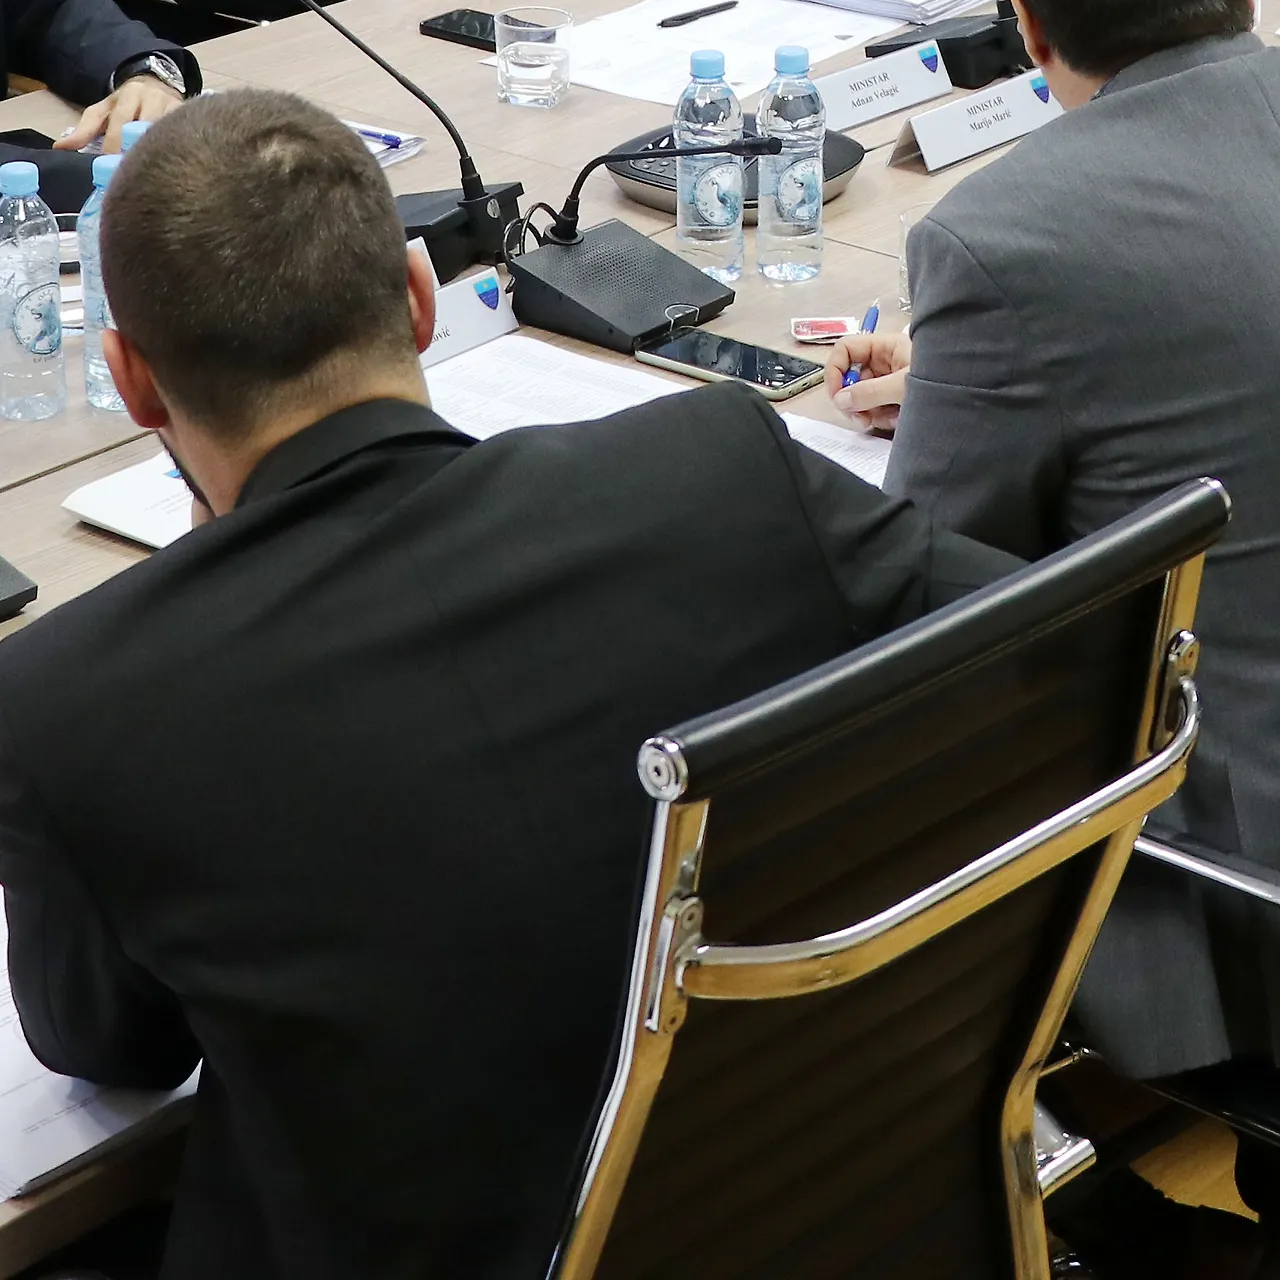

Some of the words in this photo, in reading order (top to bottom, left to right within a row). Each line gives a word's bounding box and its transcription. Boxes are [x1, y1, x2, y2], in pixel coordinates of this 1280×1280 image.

[849, 72, 890, 93] MINISTAR
[851, 95, 874, 109] Adnan
[874, 84, 899, 100] Velagić
[966, 96, 1004, 117] MINISTAR
[992, 109, 1012, 124] Marić
[431, 326, 451, 343] ović
